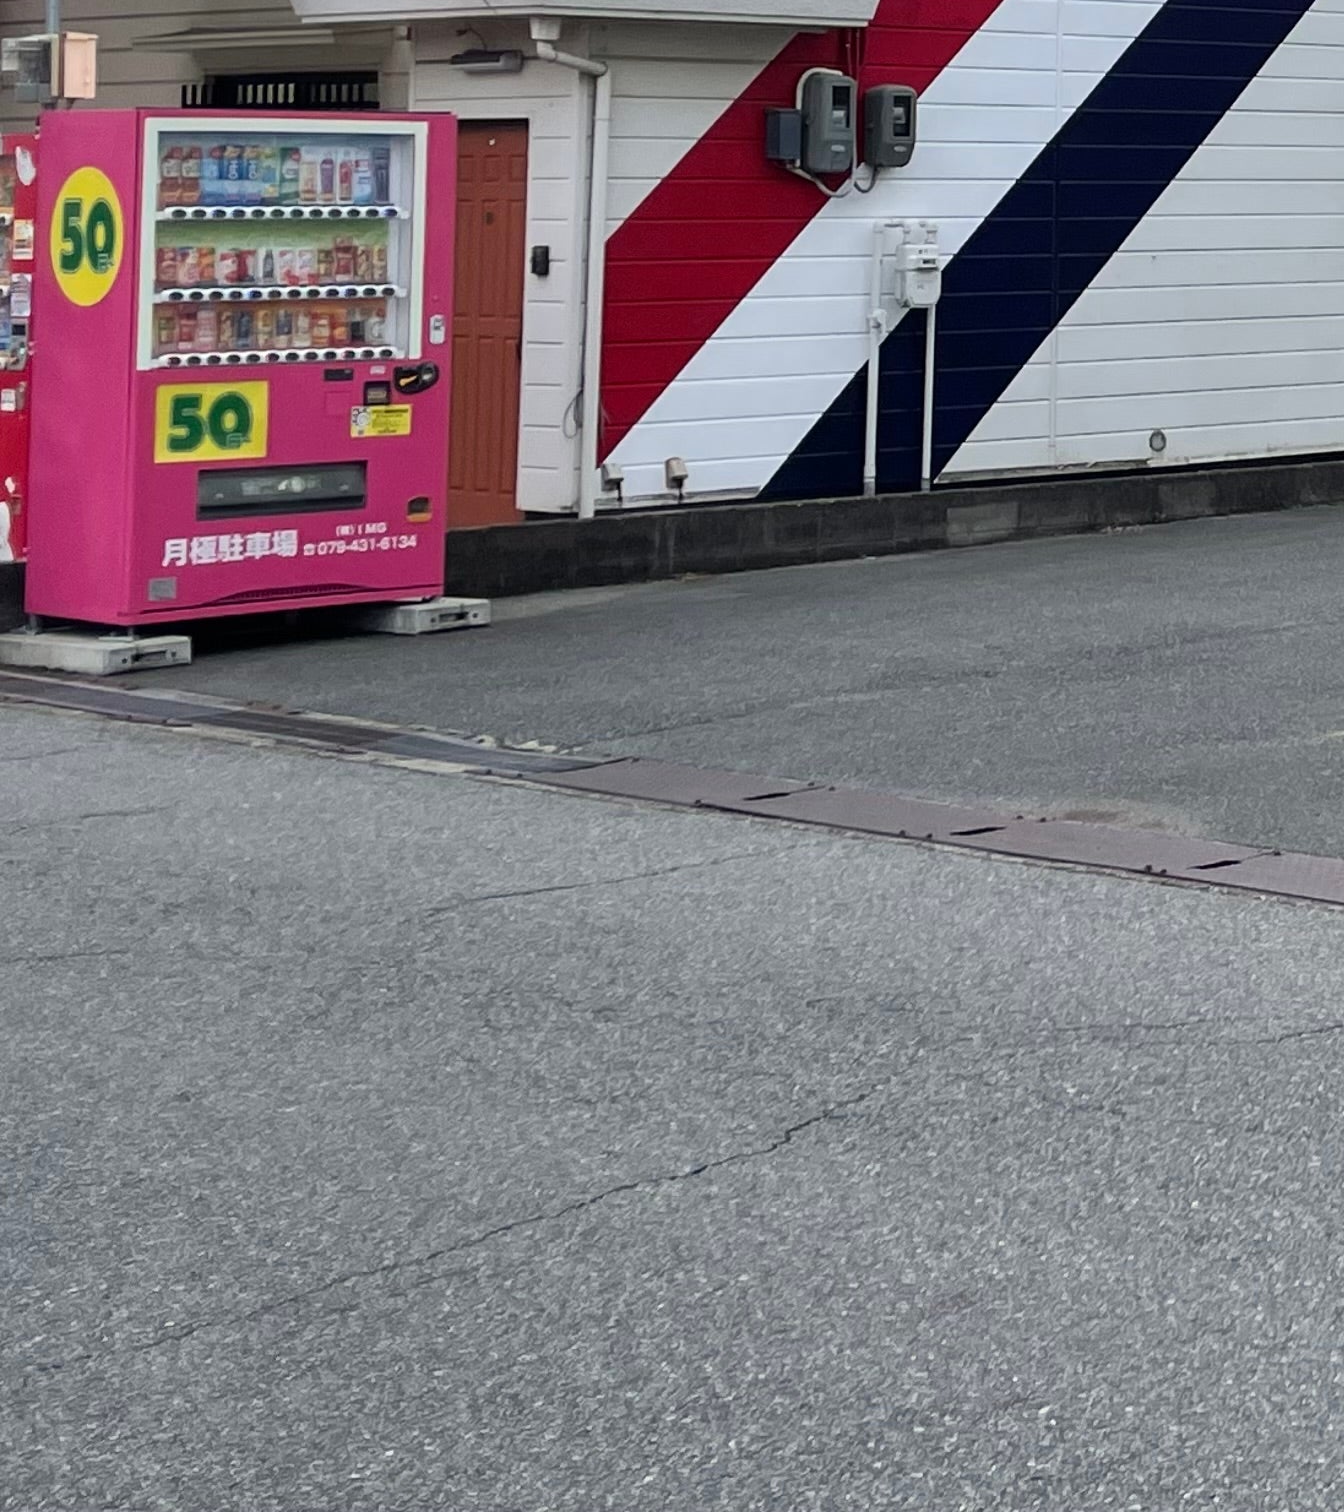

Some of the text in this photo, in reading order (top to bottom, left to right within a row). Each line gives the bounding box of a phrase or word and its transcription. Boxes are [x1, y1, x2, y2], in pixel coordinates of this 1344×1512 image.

[162, 529, 299, 566] 月極駐車場
